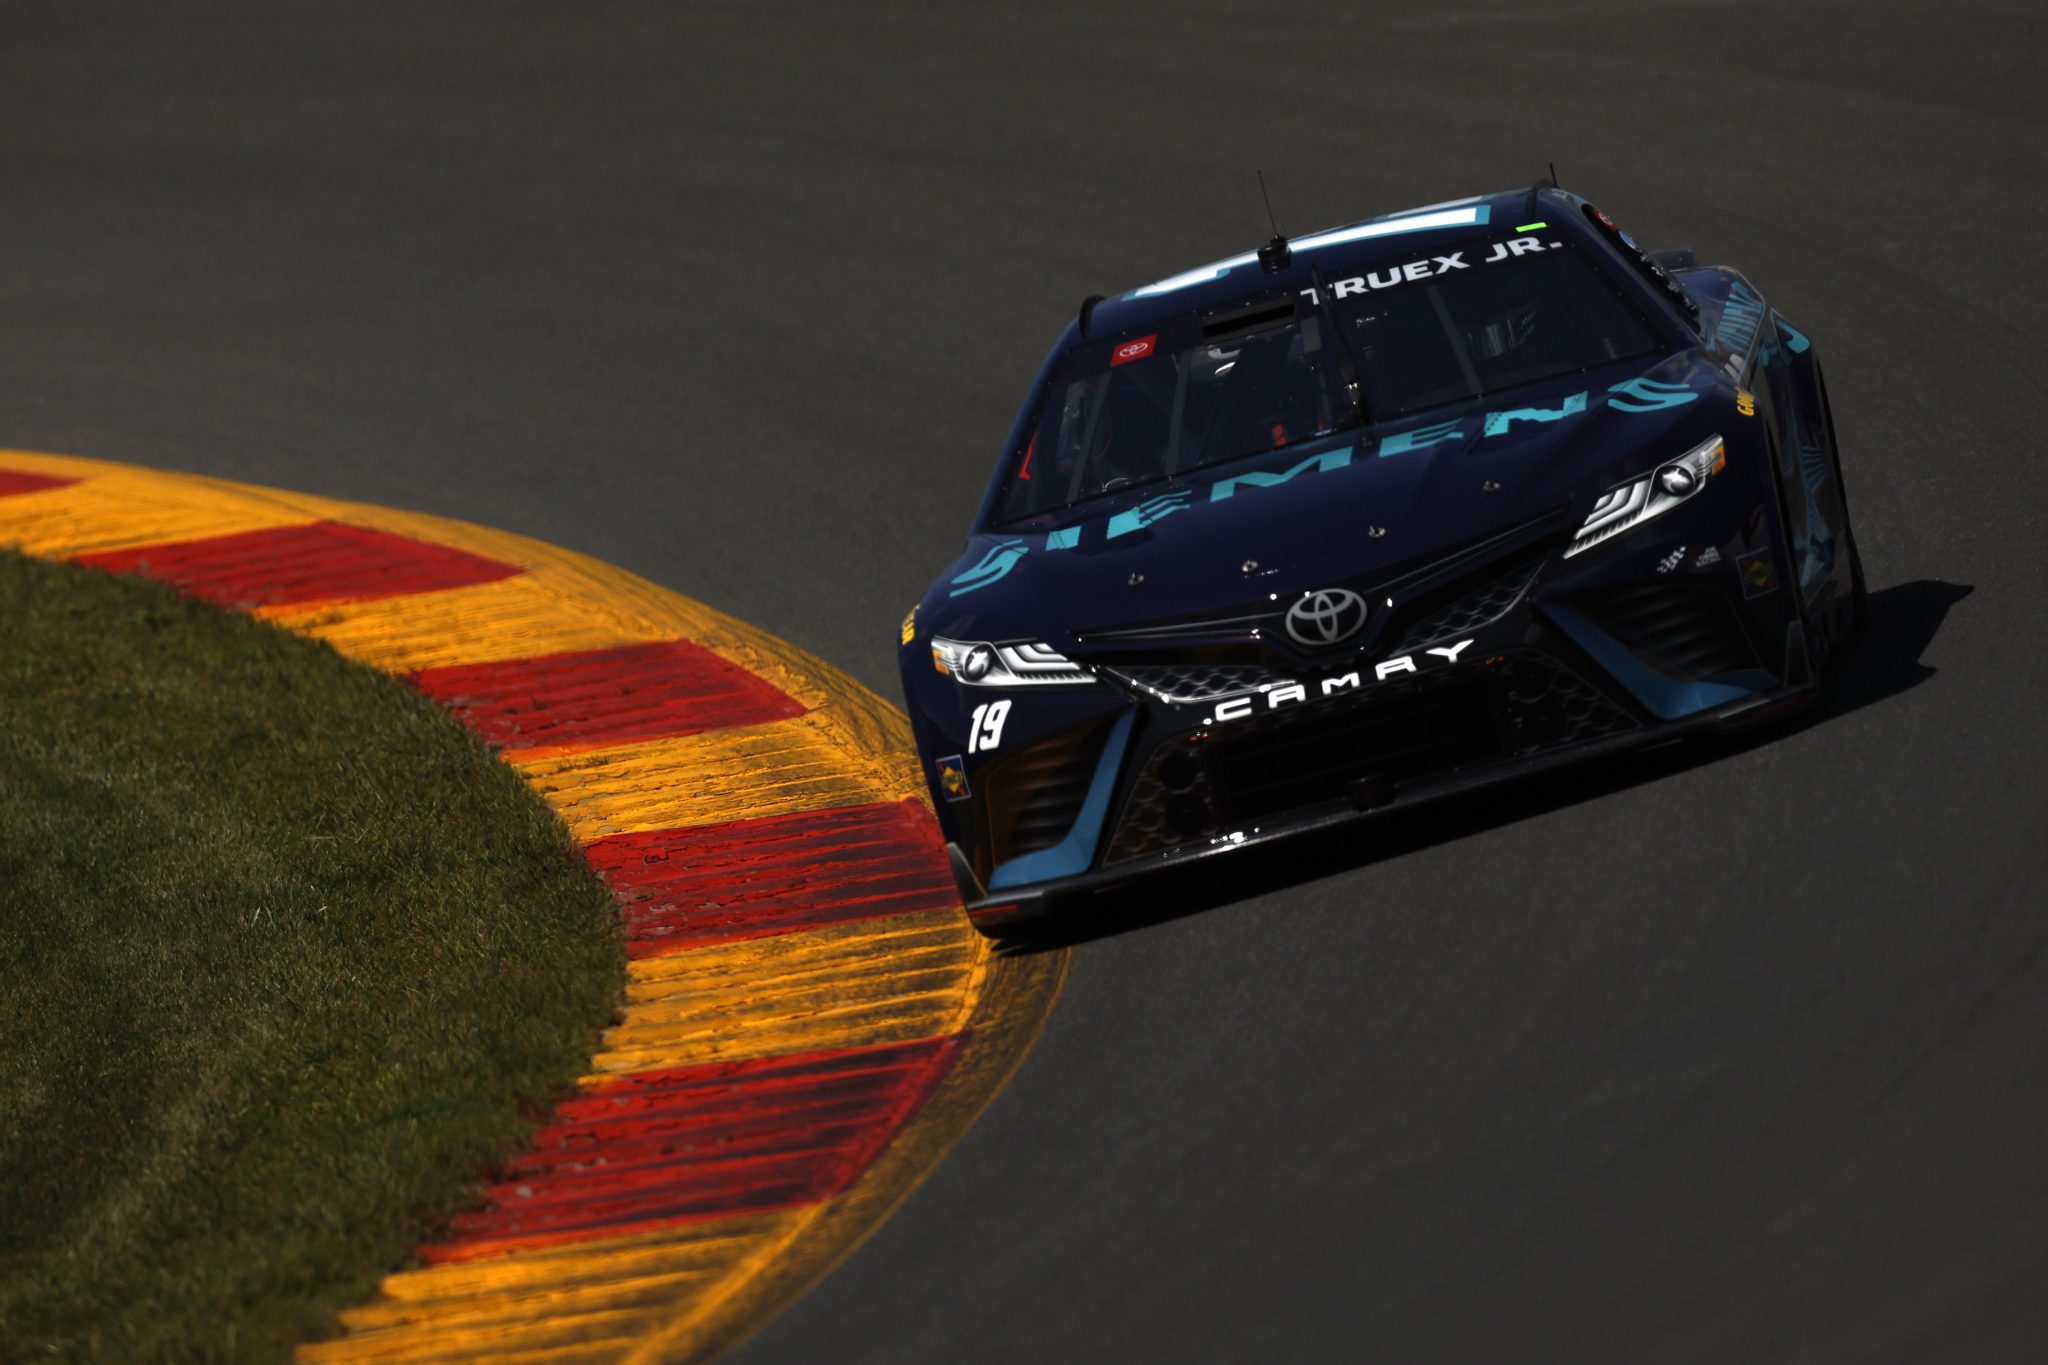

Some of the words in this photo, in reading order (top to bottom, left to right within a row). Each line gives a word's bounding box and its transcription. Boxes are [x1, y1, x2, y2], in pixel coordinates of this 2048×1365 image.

[1300, 251, 1471, 305] TRUEX
[1484, 236, 1563, 264] JR.
[948, 377, 1699, 598] SIEMENS
[1214, 638, 1474, 722] CAMRY
[968, 700, 1012, 754] 19
